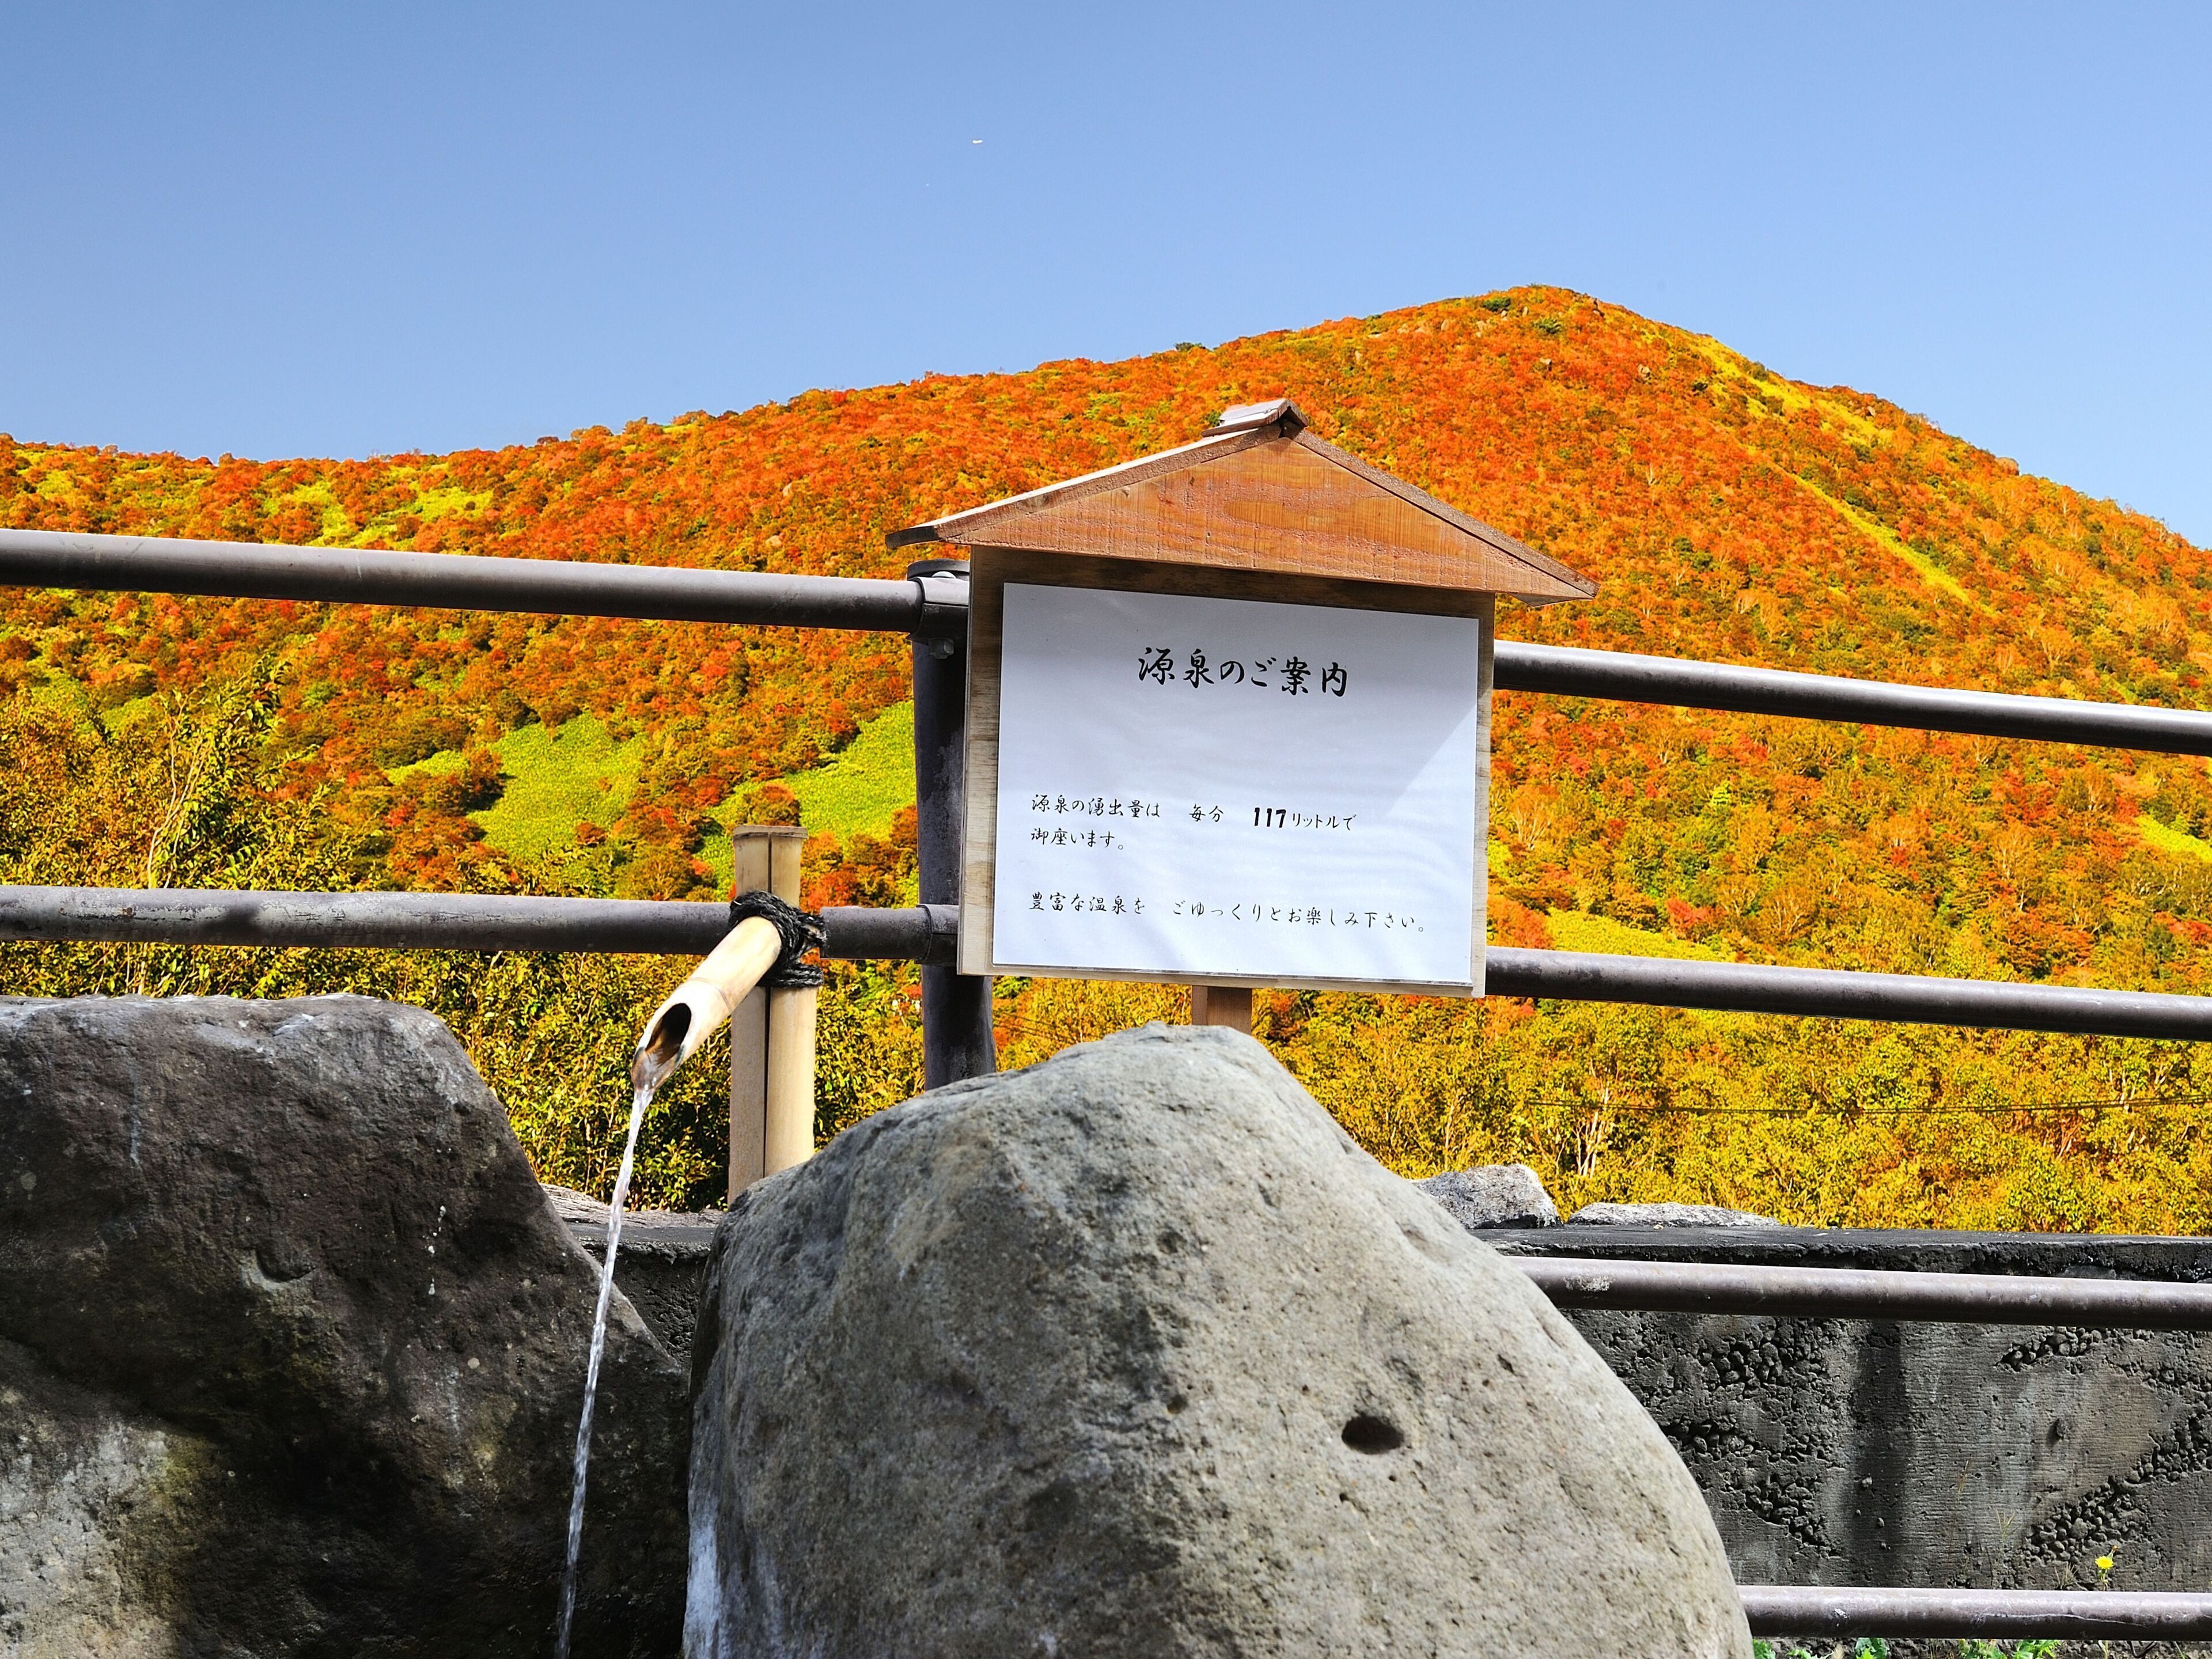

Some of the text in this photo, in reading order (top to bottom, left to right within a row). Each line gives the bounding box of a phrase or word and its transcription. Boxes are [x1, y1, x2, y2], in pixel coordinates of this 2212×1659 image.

[1138, 647, 1347, 698] 源泉のご案内
[1032, 794, 1160, 819] 源泉の湧出量は
[1188, 803, 1225, 823] 毎分
[1031, 827, 1124, 850] 御座います。
[1028, 891, 1425, 933] 豊富な温泉を ごゆっくりとお楽しみ下さい。
